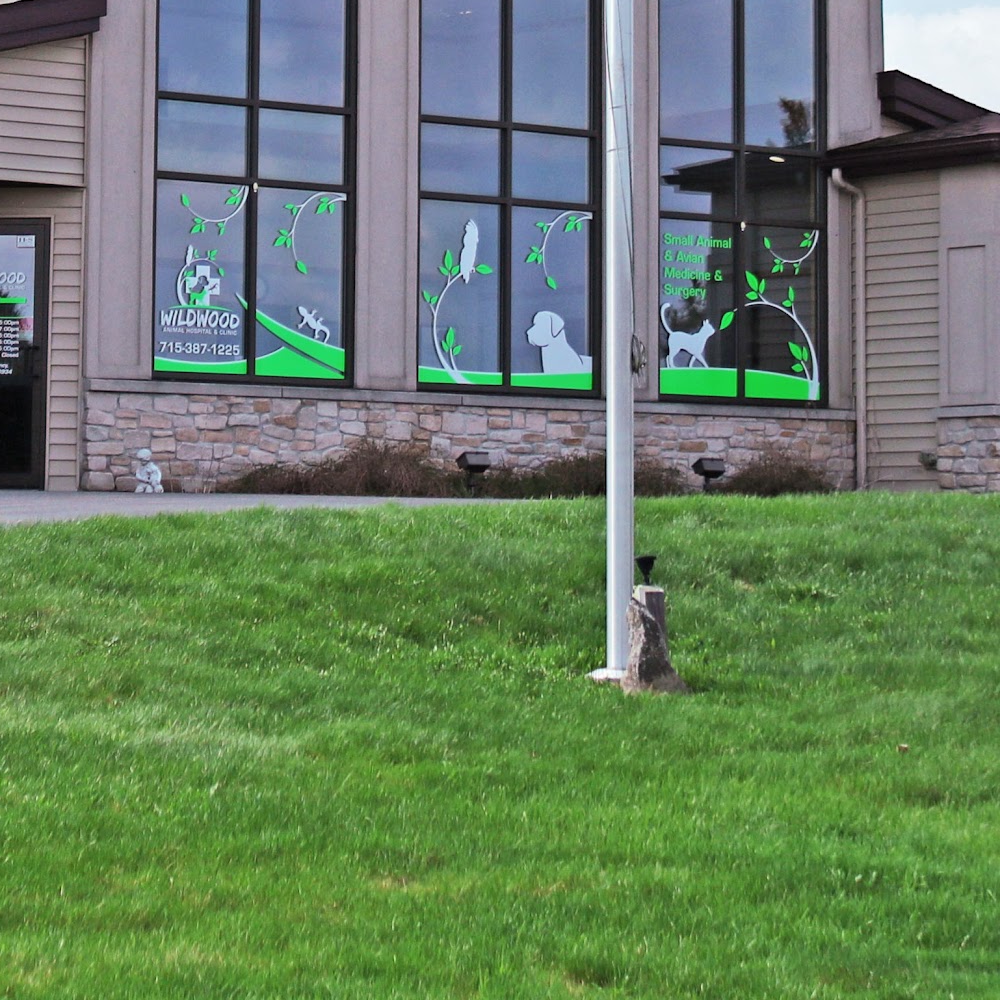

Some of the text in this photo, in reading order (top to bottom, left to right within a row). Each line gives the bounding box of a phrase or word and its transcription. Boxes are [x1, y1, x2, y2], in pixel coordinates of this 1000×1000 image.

[664, 233, 732, 249] Small Animal
[664, 250, 705, 264] & Avian
[664, 267, 723, 282] Medicine &
[664, 283, 706, 300] Surgery
[160, 309, 240, 330] WILDWOOD
[160, 342, 240, 356] 715-387-1225
